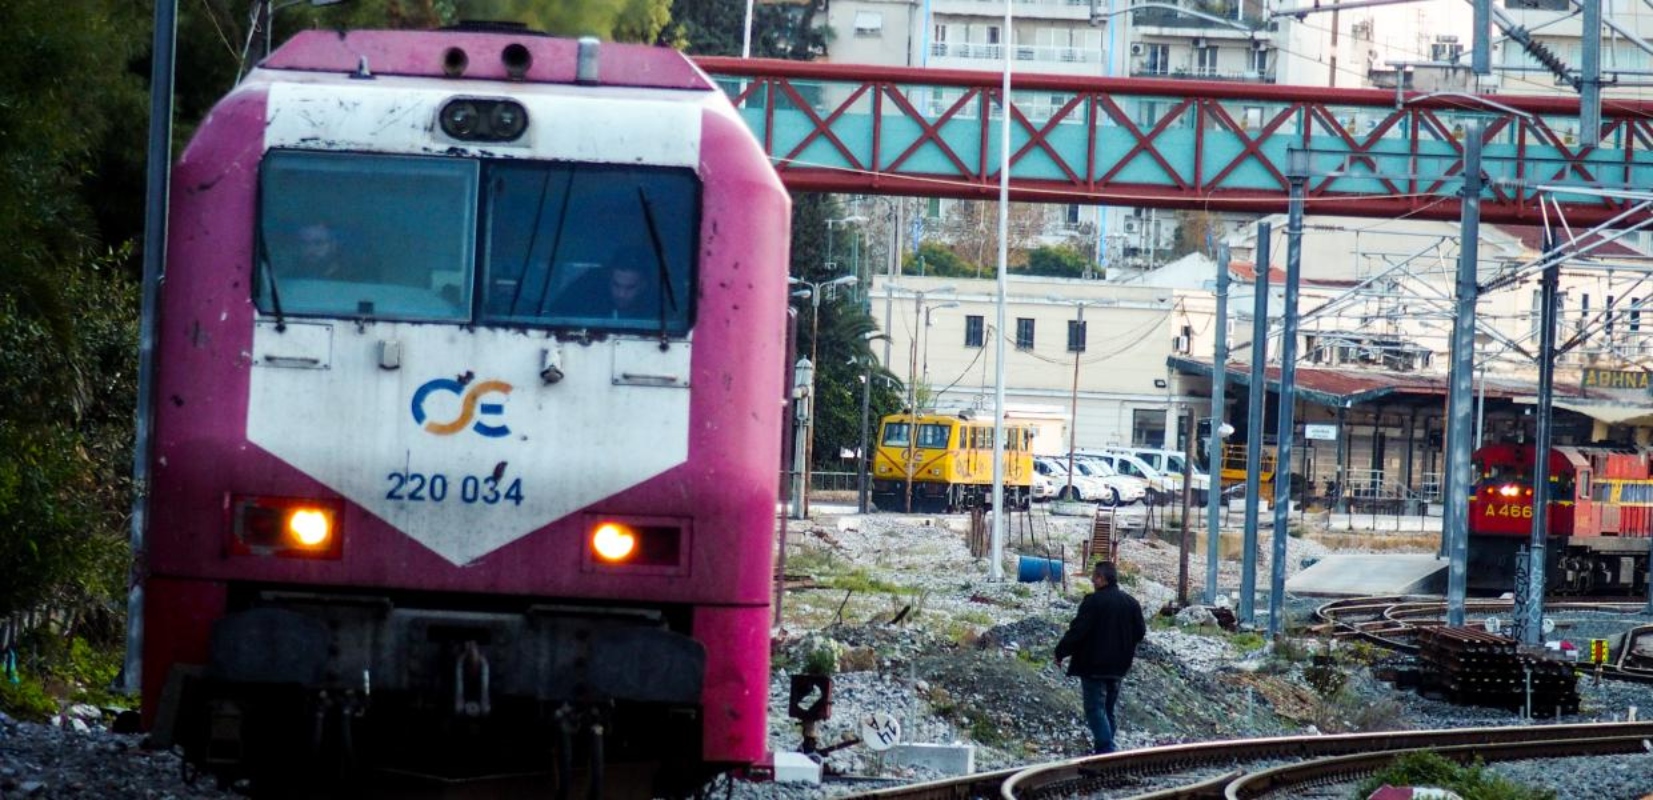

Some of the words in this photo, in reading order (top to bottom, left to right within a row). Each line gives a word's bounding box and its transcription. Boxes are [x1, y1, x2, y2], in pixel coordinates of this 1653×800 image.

[385, 472, 448, 502] 220
[460, 475, 525, 506] 034
[1485, 503, 1495, 517] A
[1498, 503, 1533, 519] 466
